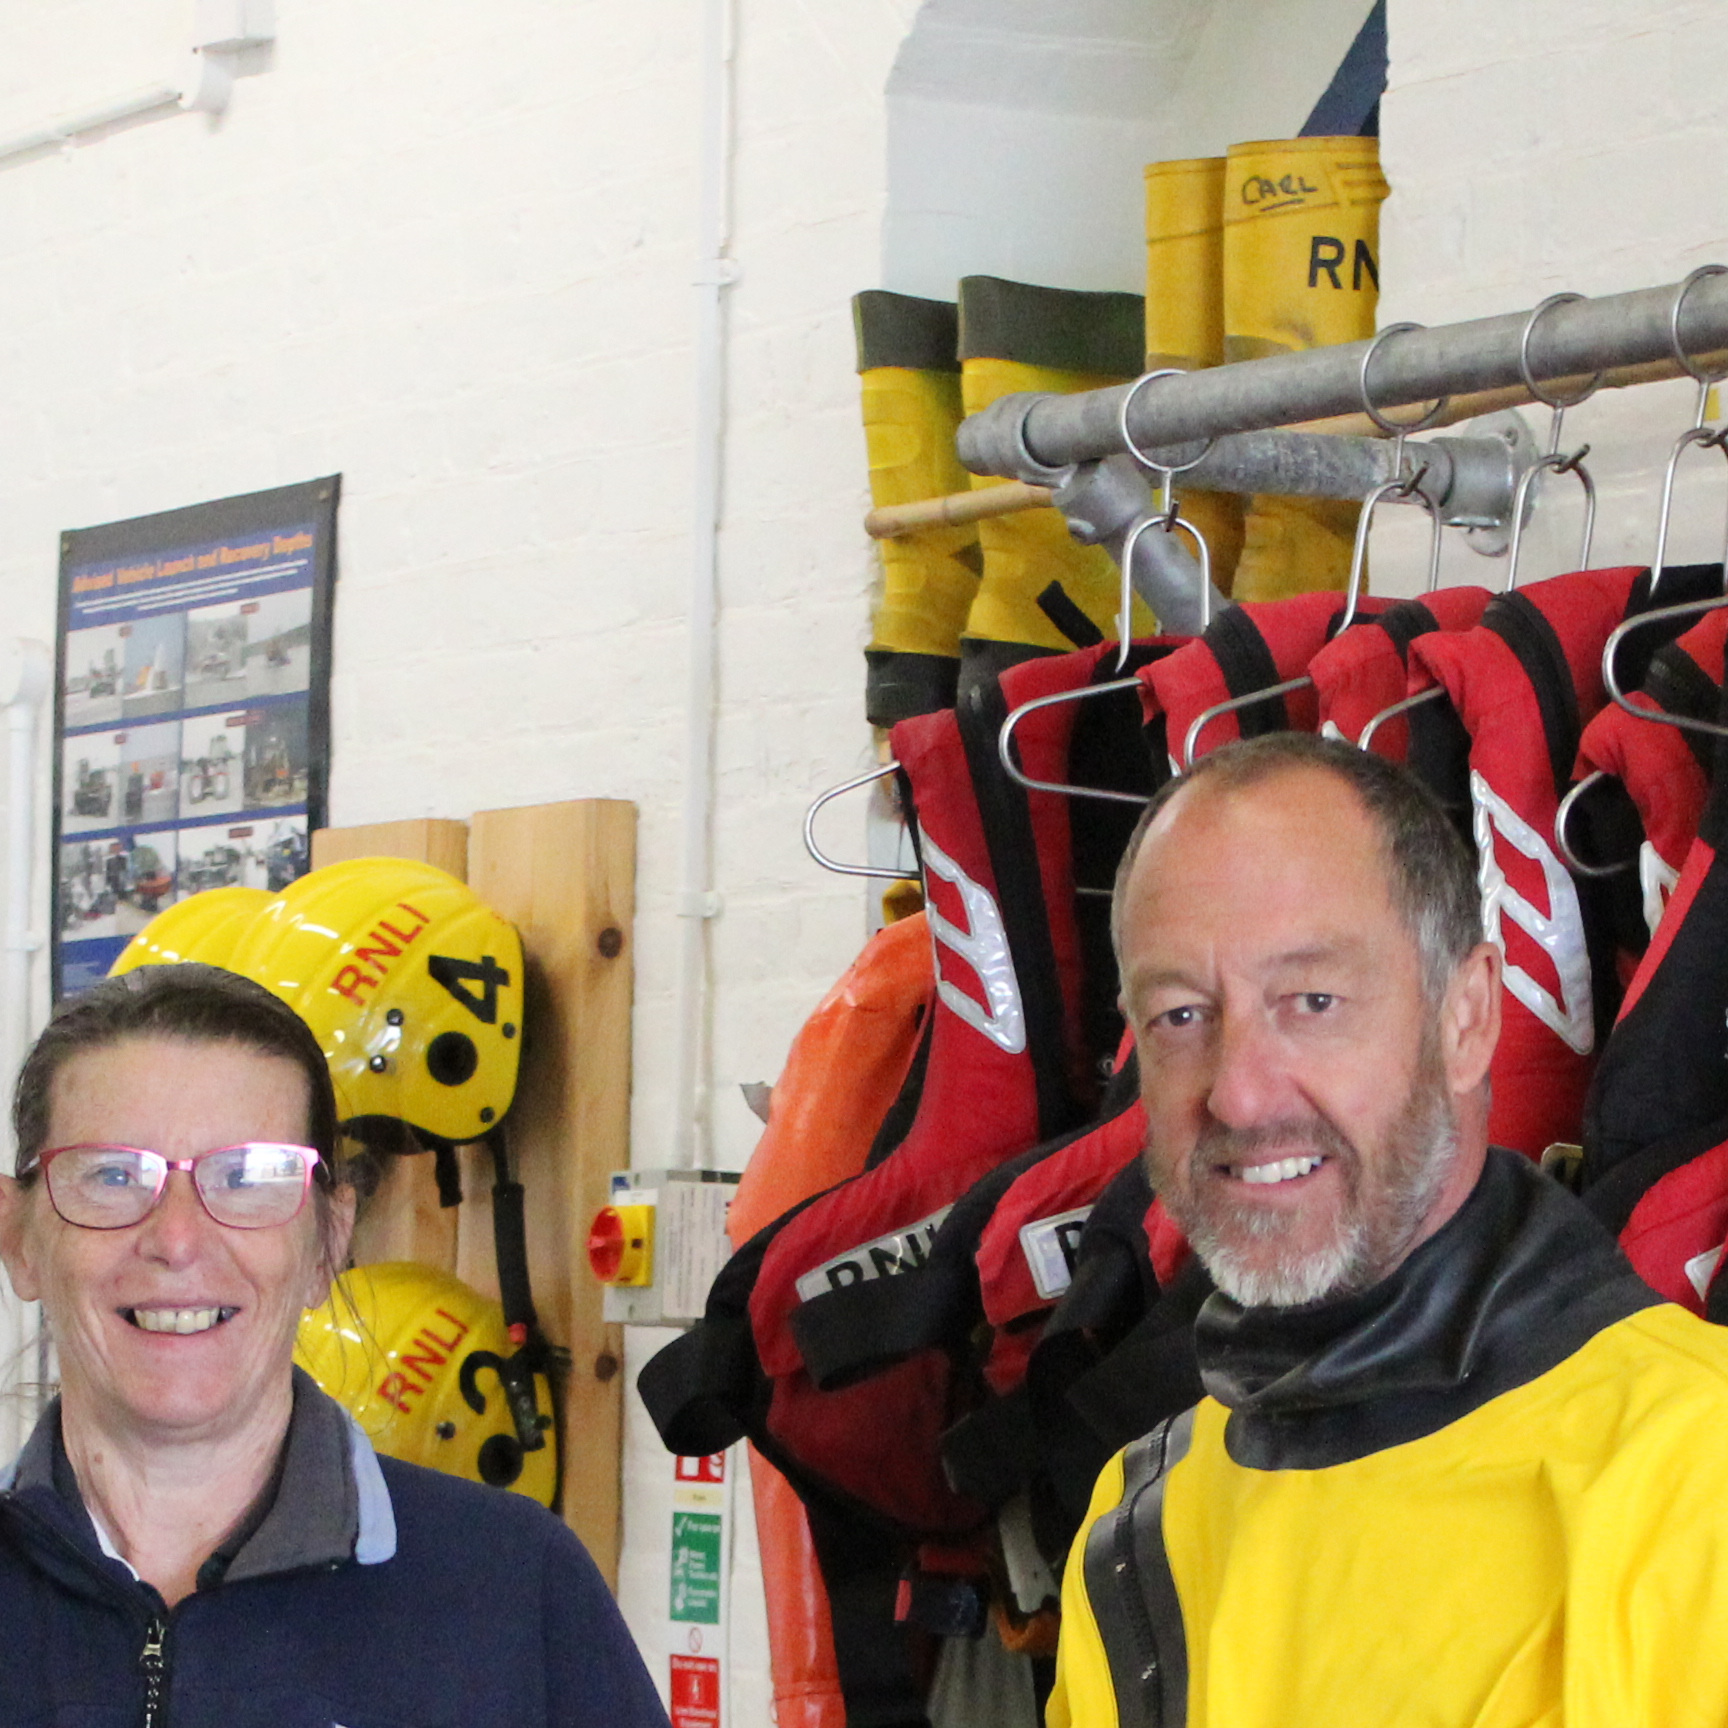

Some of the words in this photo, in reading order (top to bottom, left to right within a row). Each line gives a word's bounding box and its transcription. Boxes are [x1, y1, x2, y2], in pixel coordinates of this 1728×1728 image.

[331, 902, 430, 1007] RNLI
[428, 954, 510, 1025] 4
[377, 1308, 469, 1414] RNLI
